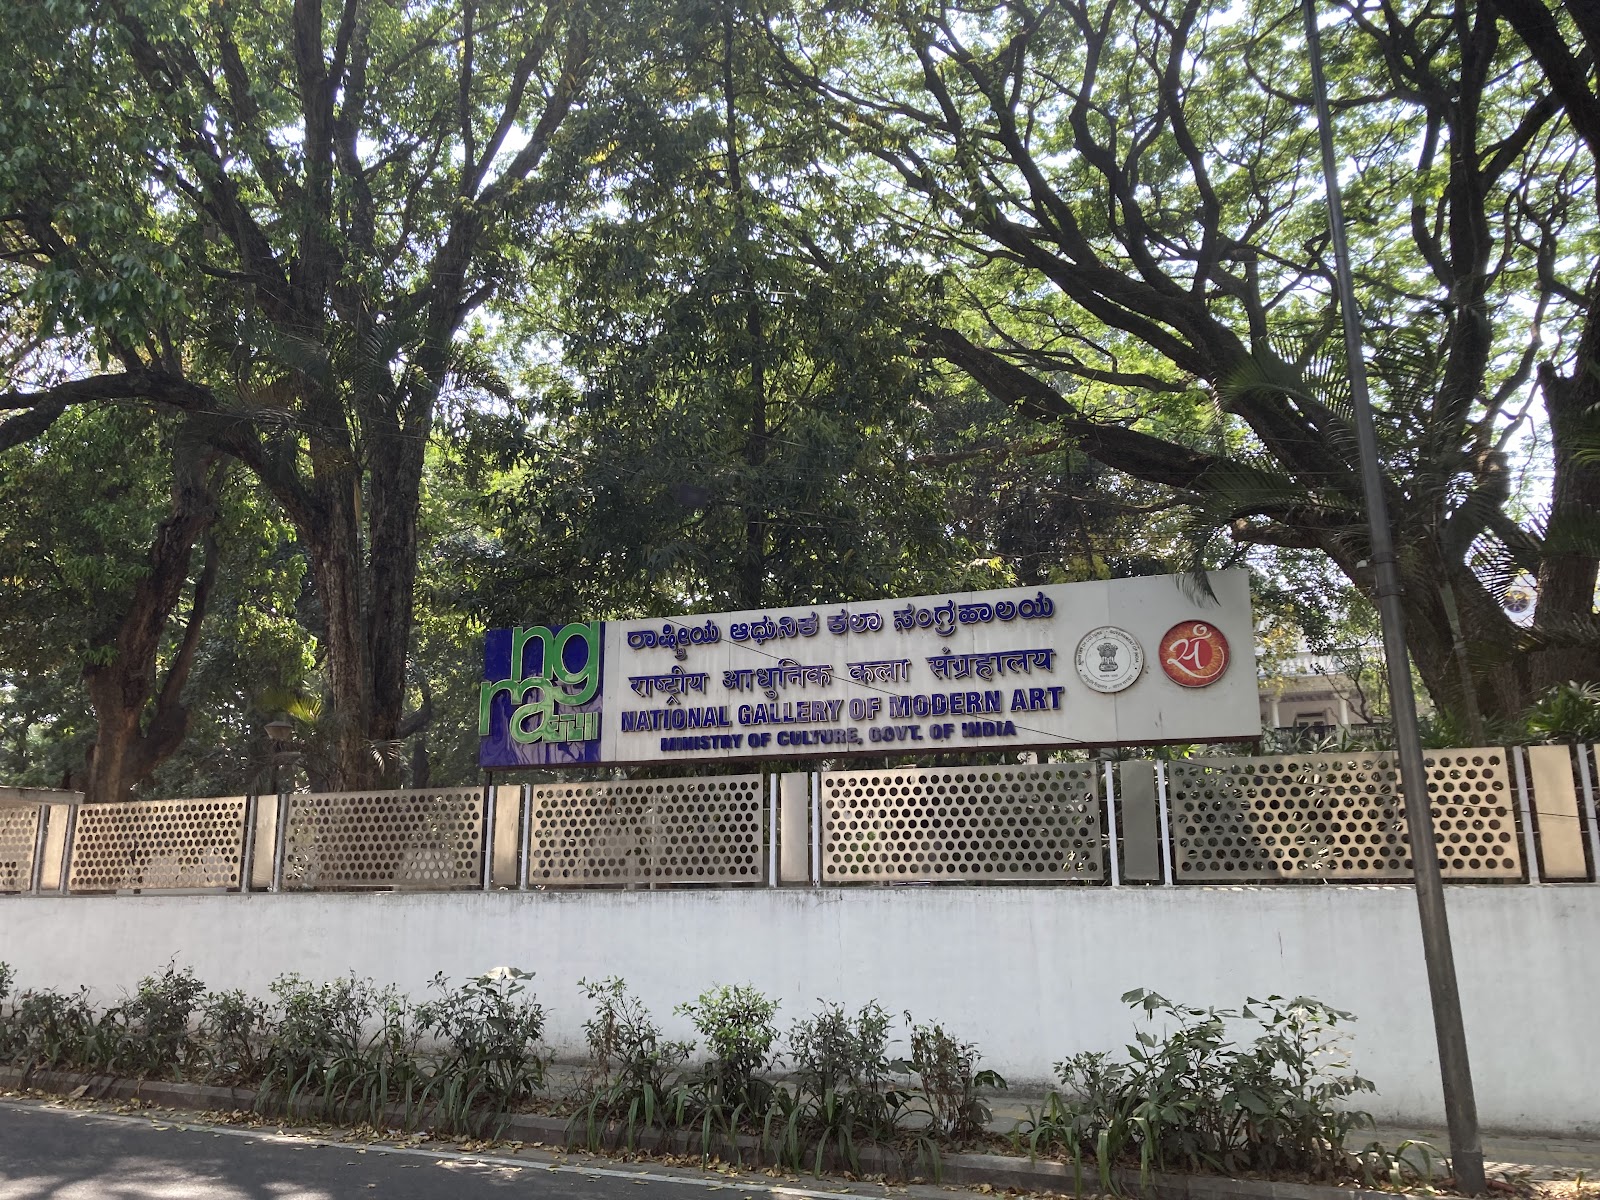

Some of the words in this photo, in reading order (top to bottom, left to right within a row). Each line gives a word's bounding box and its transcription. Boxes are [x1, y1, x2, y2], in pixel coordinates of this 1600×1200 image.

[730, 611, 819, 645] ಆಧುನಿಕ
[827, 609, 884, 634] ಕಲಾ
[893, 591, 1056, 636] ಸಂಗ್ರಹಾಲಯ
[628, 665, 710, 705] राष्ट्रीय
[722, 658, 833, 700] आधुनिक
[846, 658, 911, 683] कला
[925, 647, 1056, 682] संग्रहालय
[621, 705, 731, 732] NATIONAL
[738, 699, 844, 726] GALLERY
[849, 697, 881, 720] OF
[889, 690, 1002, 719] MODERN
[1010, 686, 1064, 712] ART
[661, 733, 744, 751] MINISTRY
[748, 732, 772, 748] OF
[777, 728, 863, 746] CULTURE,
[868, 725, 924, 742] GOVT.
[929, 723, 955, 739] OF
[961, 720, 1017, 738] INDIA
